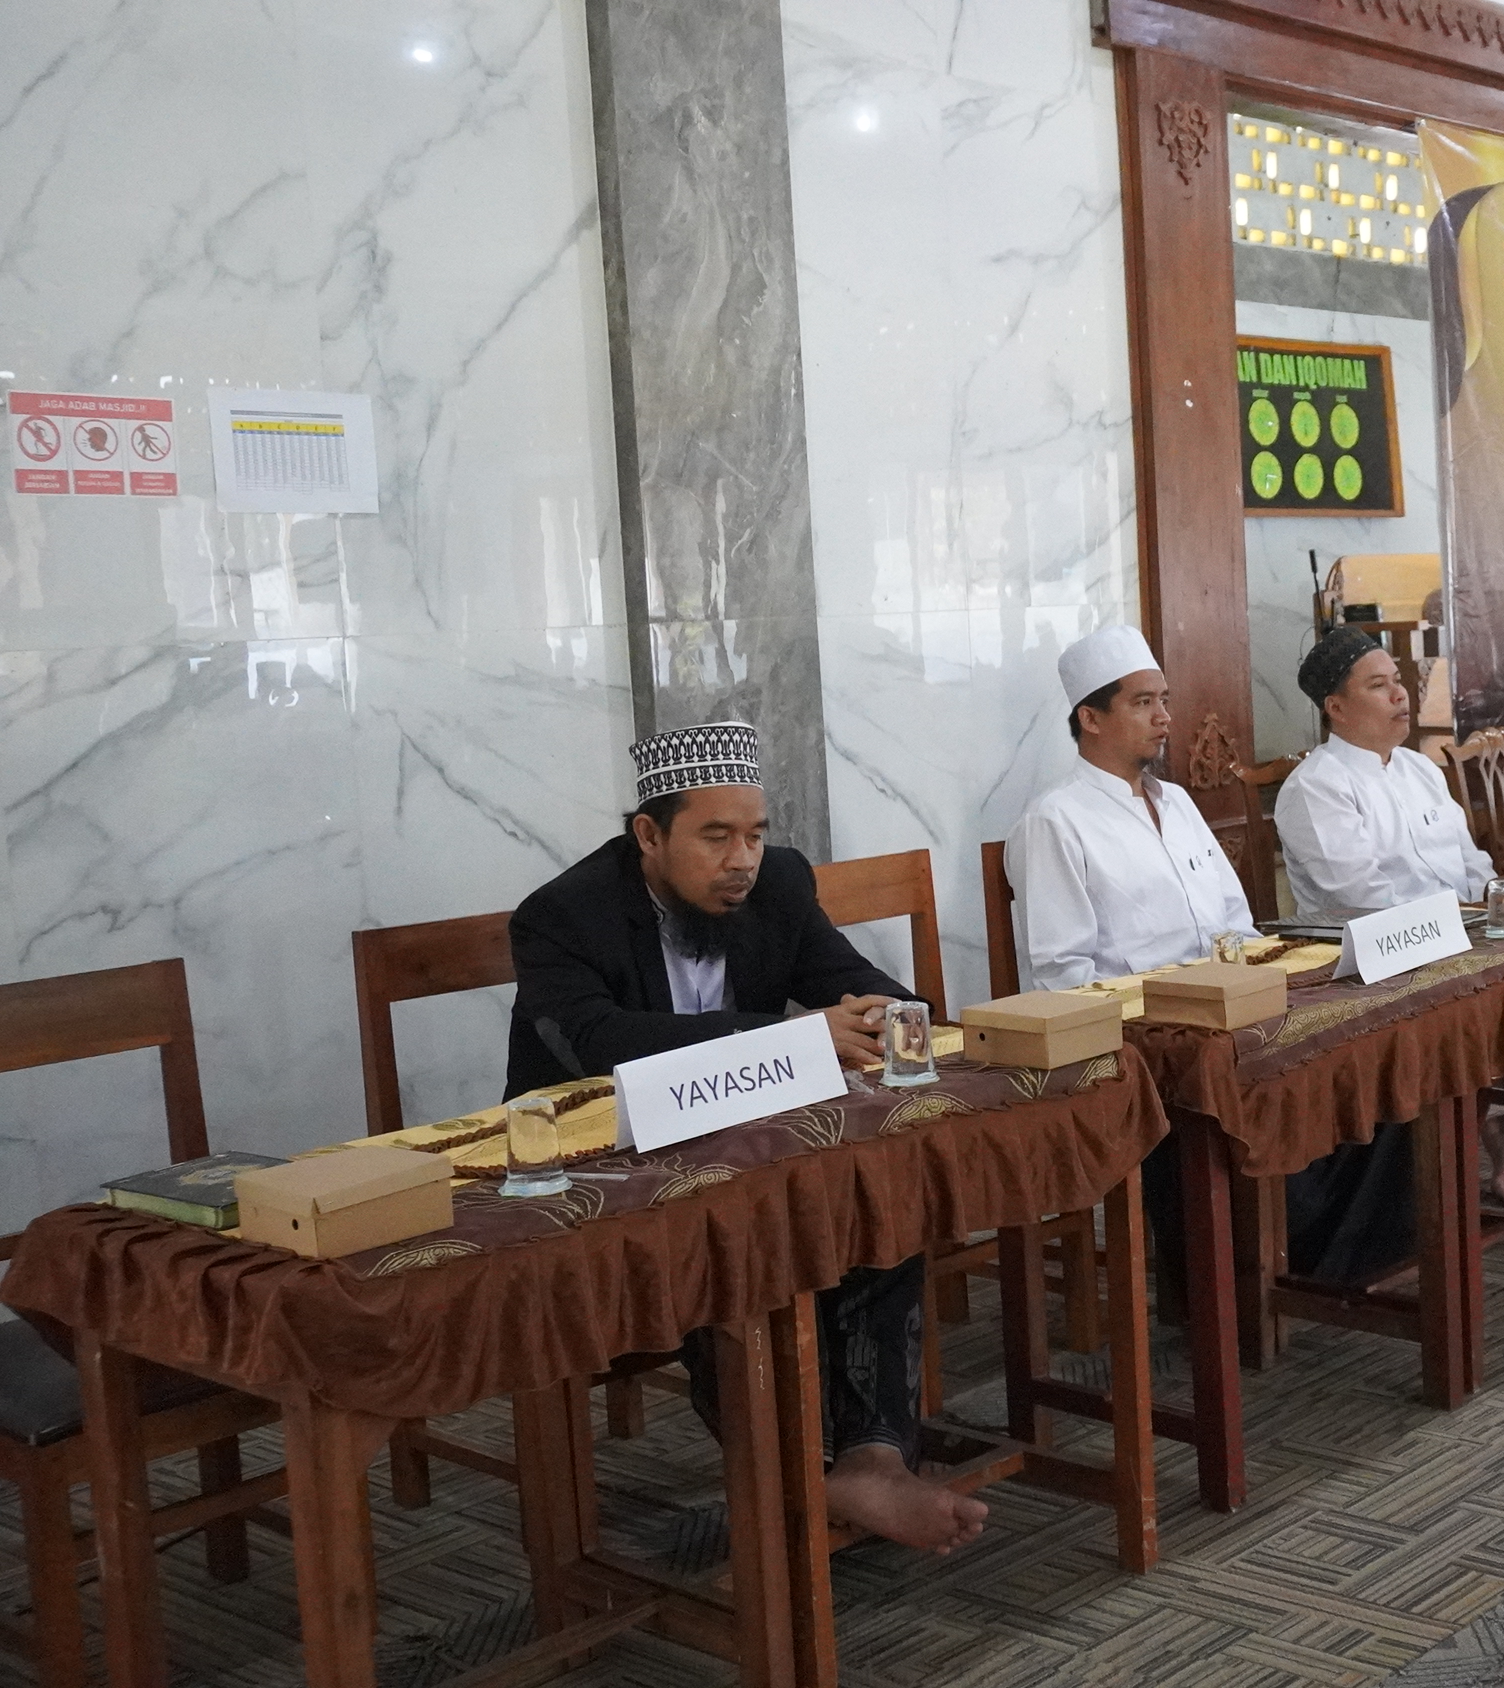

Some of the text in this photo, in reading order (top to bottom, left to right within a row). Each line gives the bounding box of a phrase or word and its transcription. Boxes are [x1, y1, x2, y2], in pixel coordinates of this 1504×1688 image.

[1259, 352, 1297, 385] DAN
[1296, 355, 1367, 389] IQOMAH
[38, 400, 66, 410] JAGA
[67, 401, 96, 411] ADAB
[1375, 920, 1442, 957] YAYASAN
[669, 1055, 796, 1111] YAYASAN
